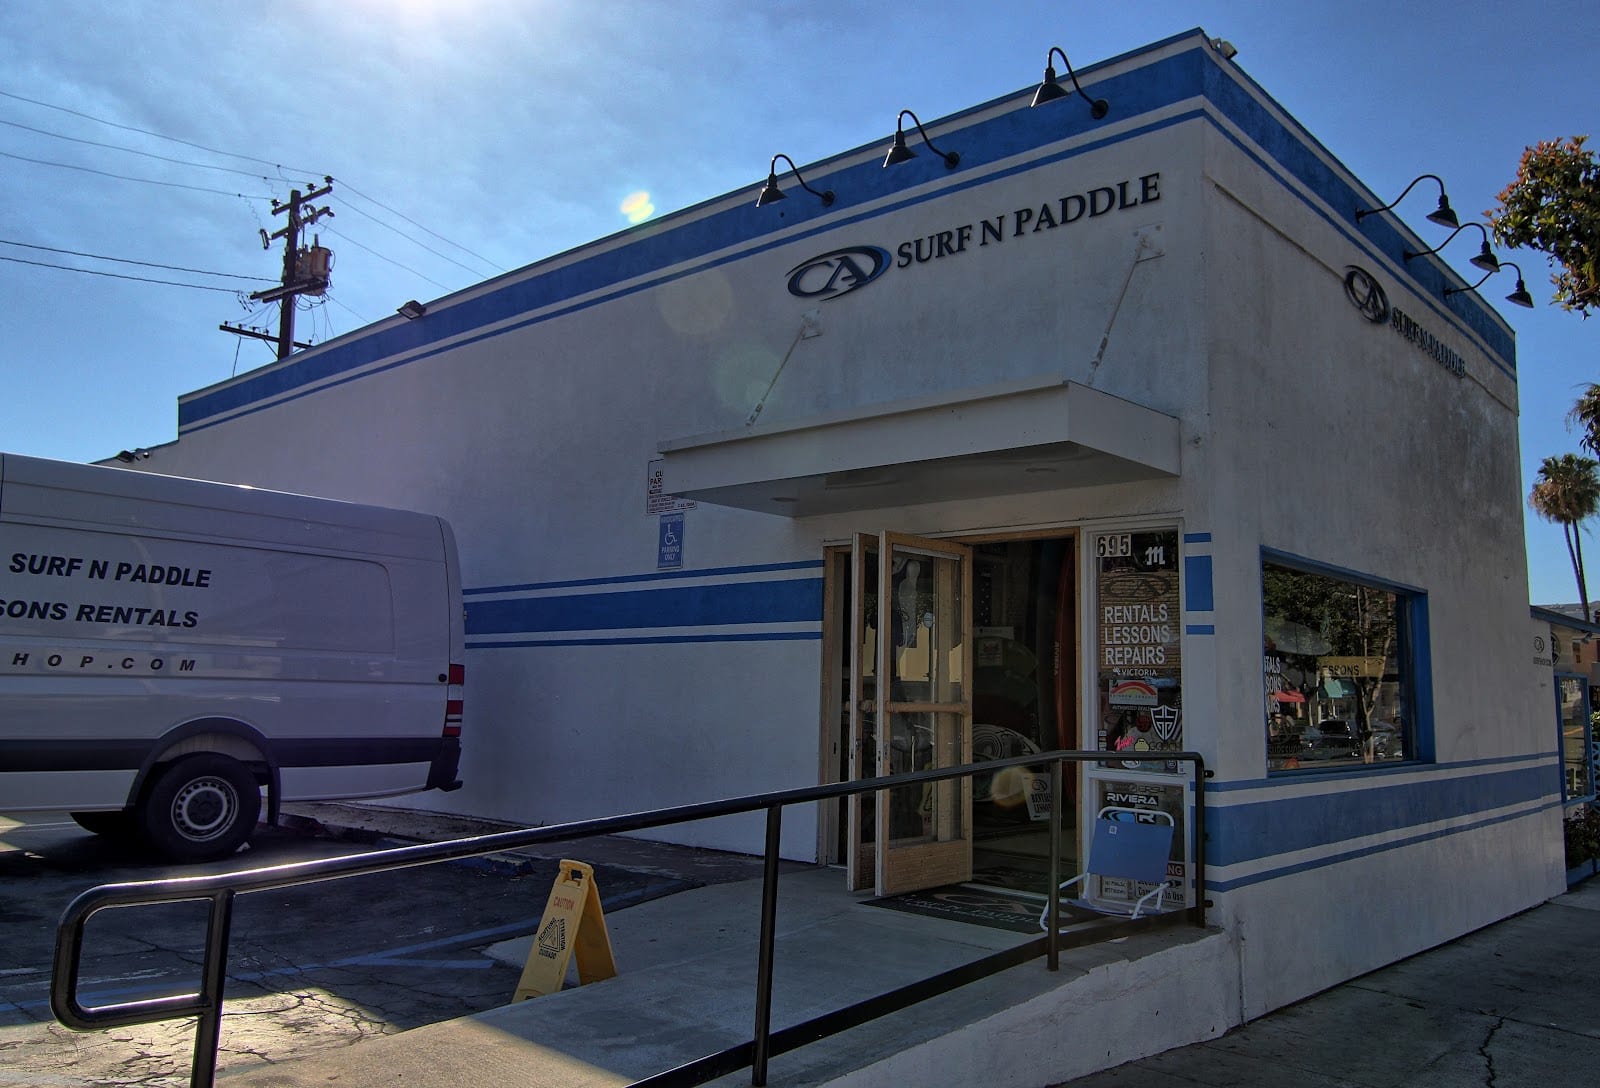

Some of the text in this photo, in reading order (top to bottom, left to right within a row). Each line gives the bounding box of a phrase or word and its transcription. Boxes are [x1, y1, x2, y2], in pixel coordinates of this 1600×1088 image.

[897, 224, 973, 269] SURF
[979, 215, 1005, 247] N
[1013, 172, 1162, 238] PADDLE
[1392, 307, 1420, 342] SURF
[1097, 535, 1130, 557] 695
[9, 552, 212, 588] SURF N PADDLE
[76, 604, 199, 628] RENTALS
[1104, 603, 1168, 624] RENTALS
[1104, 624, 1170, 645] LESSONS
[1105, 646, 1165, 665] REPAIRS
[1121, 667, 1158, 677] VICTORIA
[1107, 792, 1158, 806] RIVIERA
[1168, 864, 1183, 876] NG
[554, 896, 575, 911] CAUTION
[538, 948, 557, 960] CUIDADO
